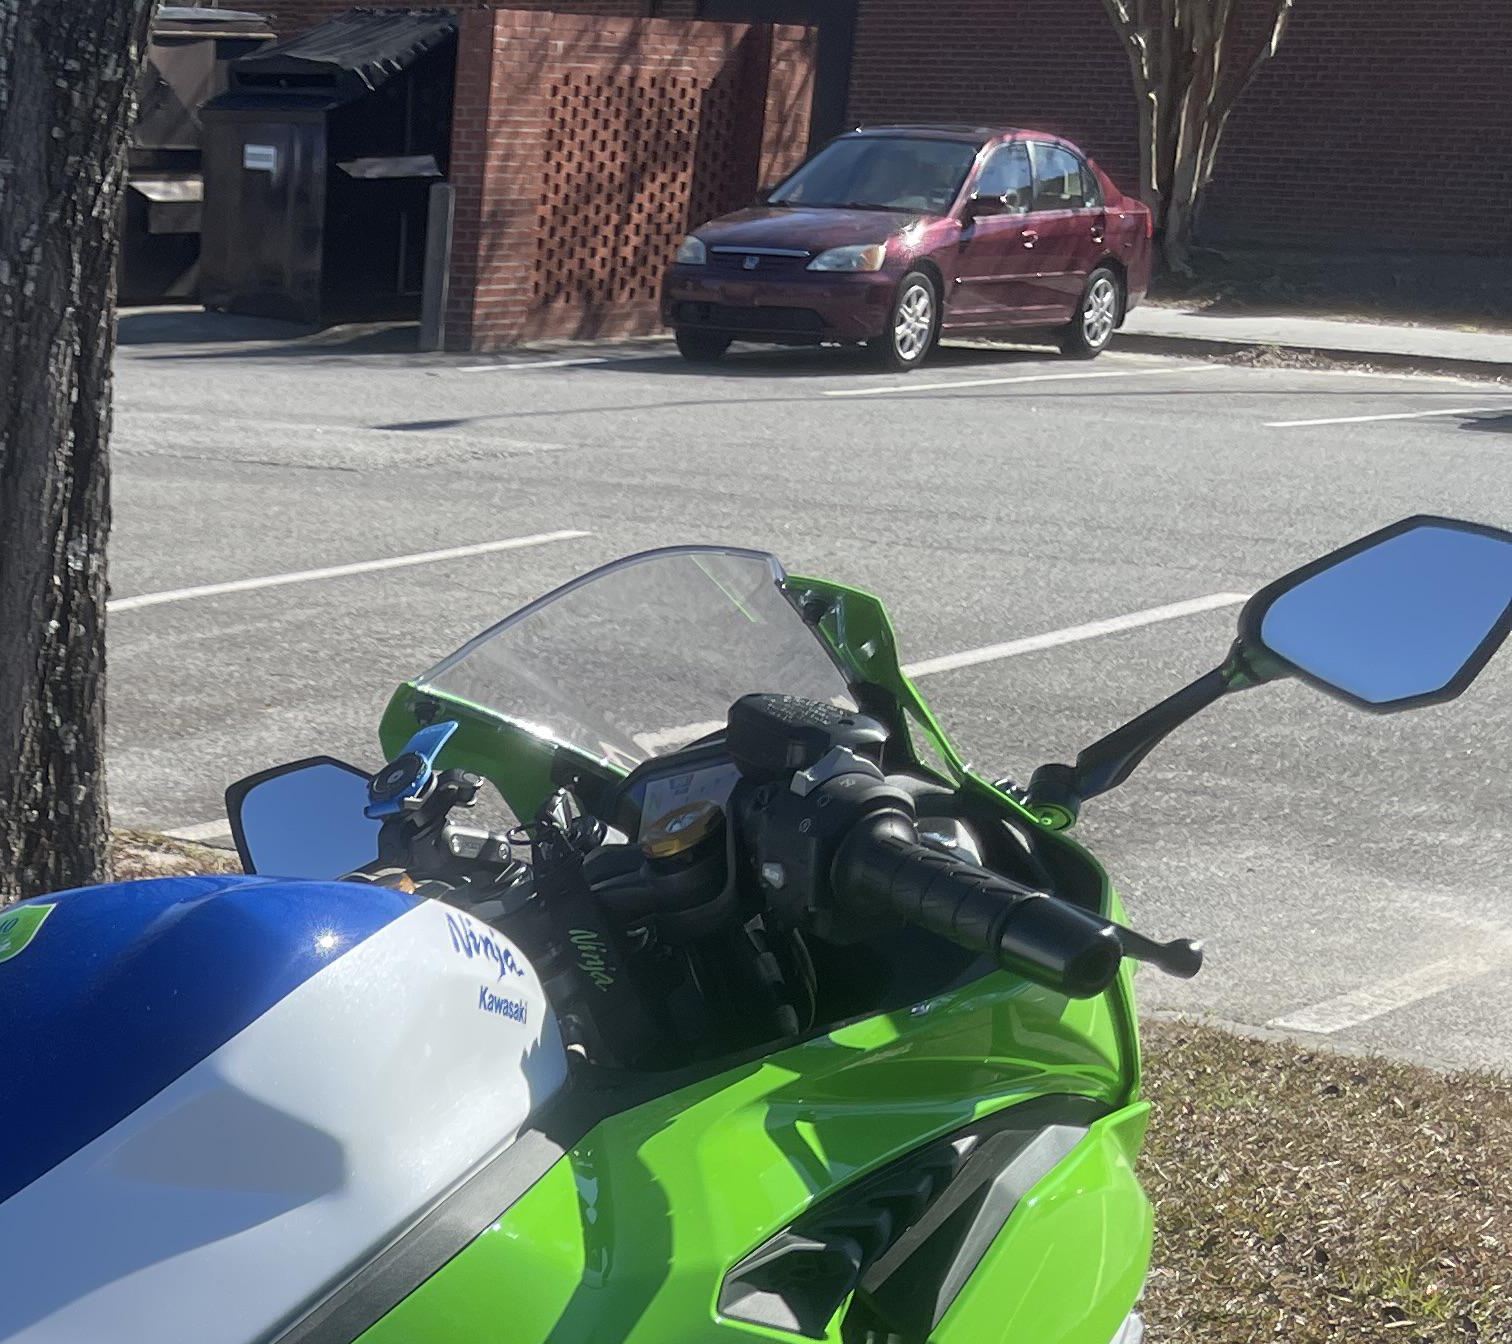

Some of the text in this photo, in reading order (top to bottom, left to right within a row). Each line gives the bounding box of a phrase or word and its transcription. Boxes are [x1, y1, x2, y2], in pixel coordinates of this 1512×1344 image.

[445, 912, 524, 983] Ninja
[568, 929, 616, 992] Ninja
[478, 985, 528, 1025] Kawasaki
